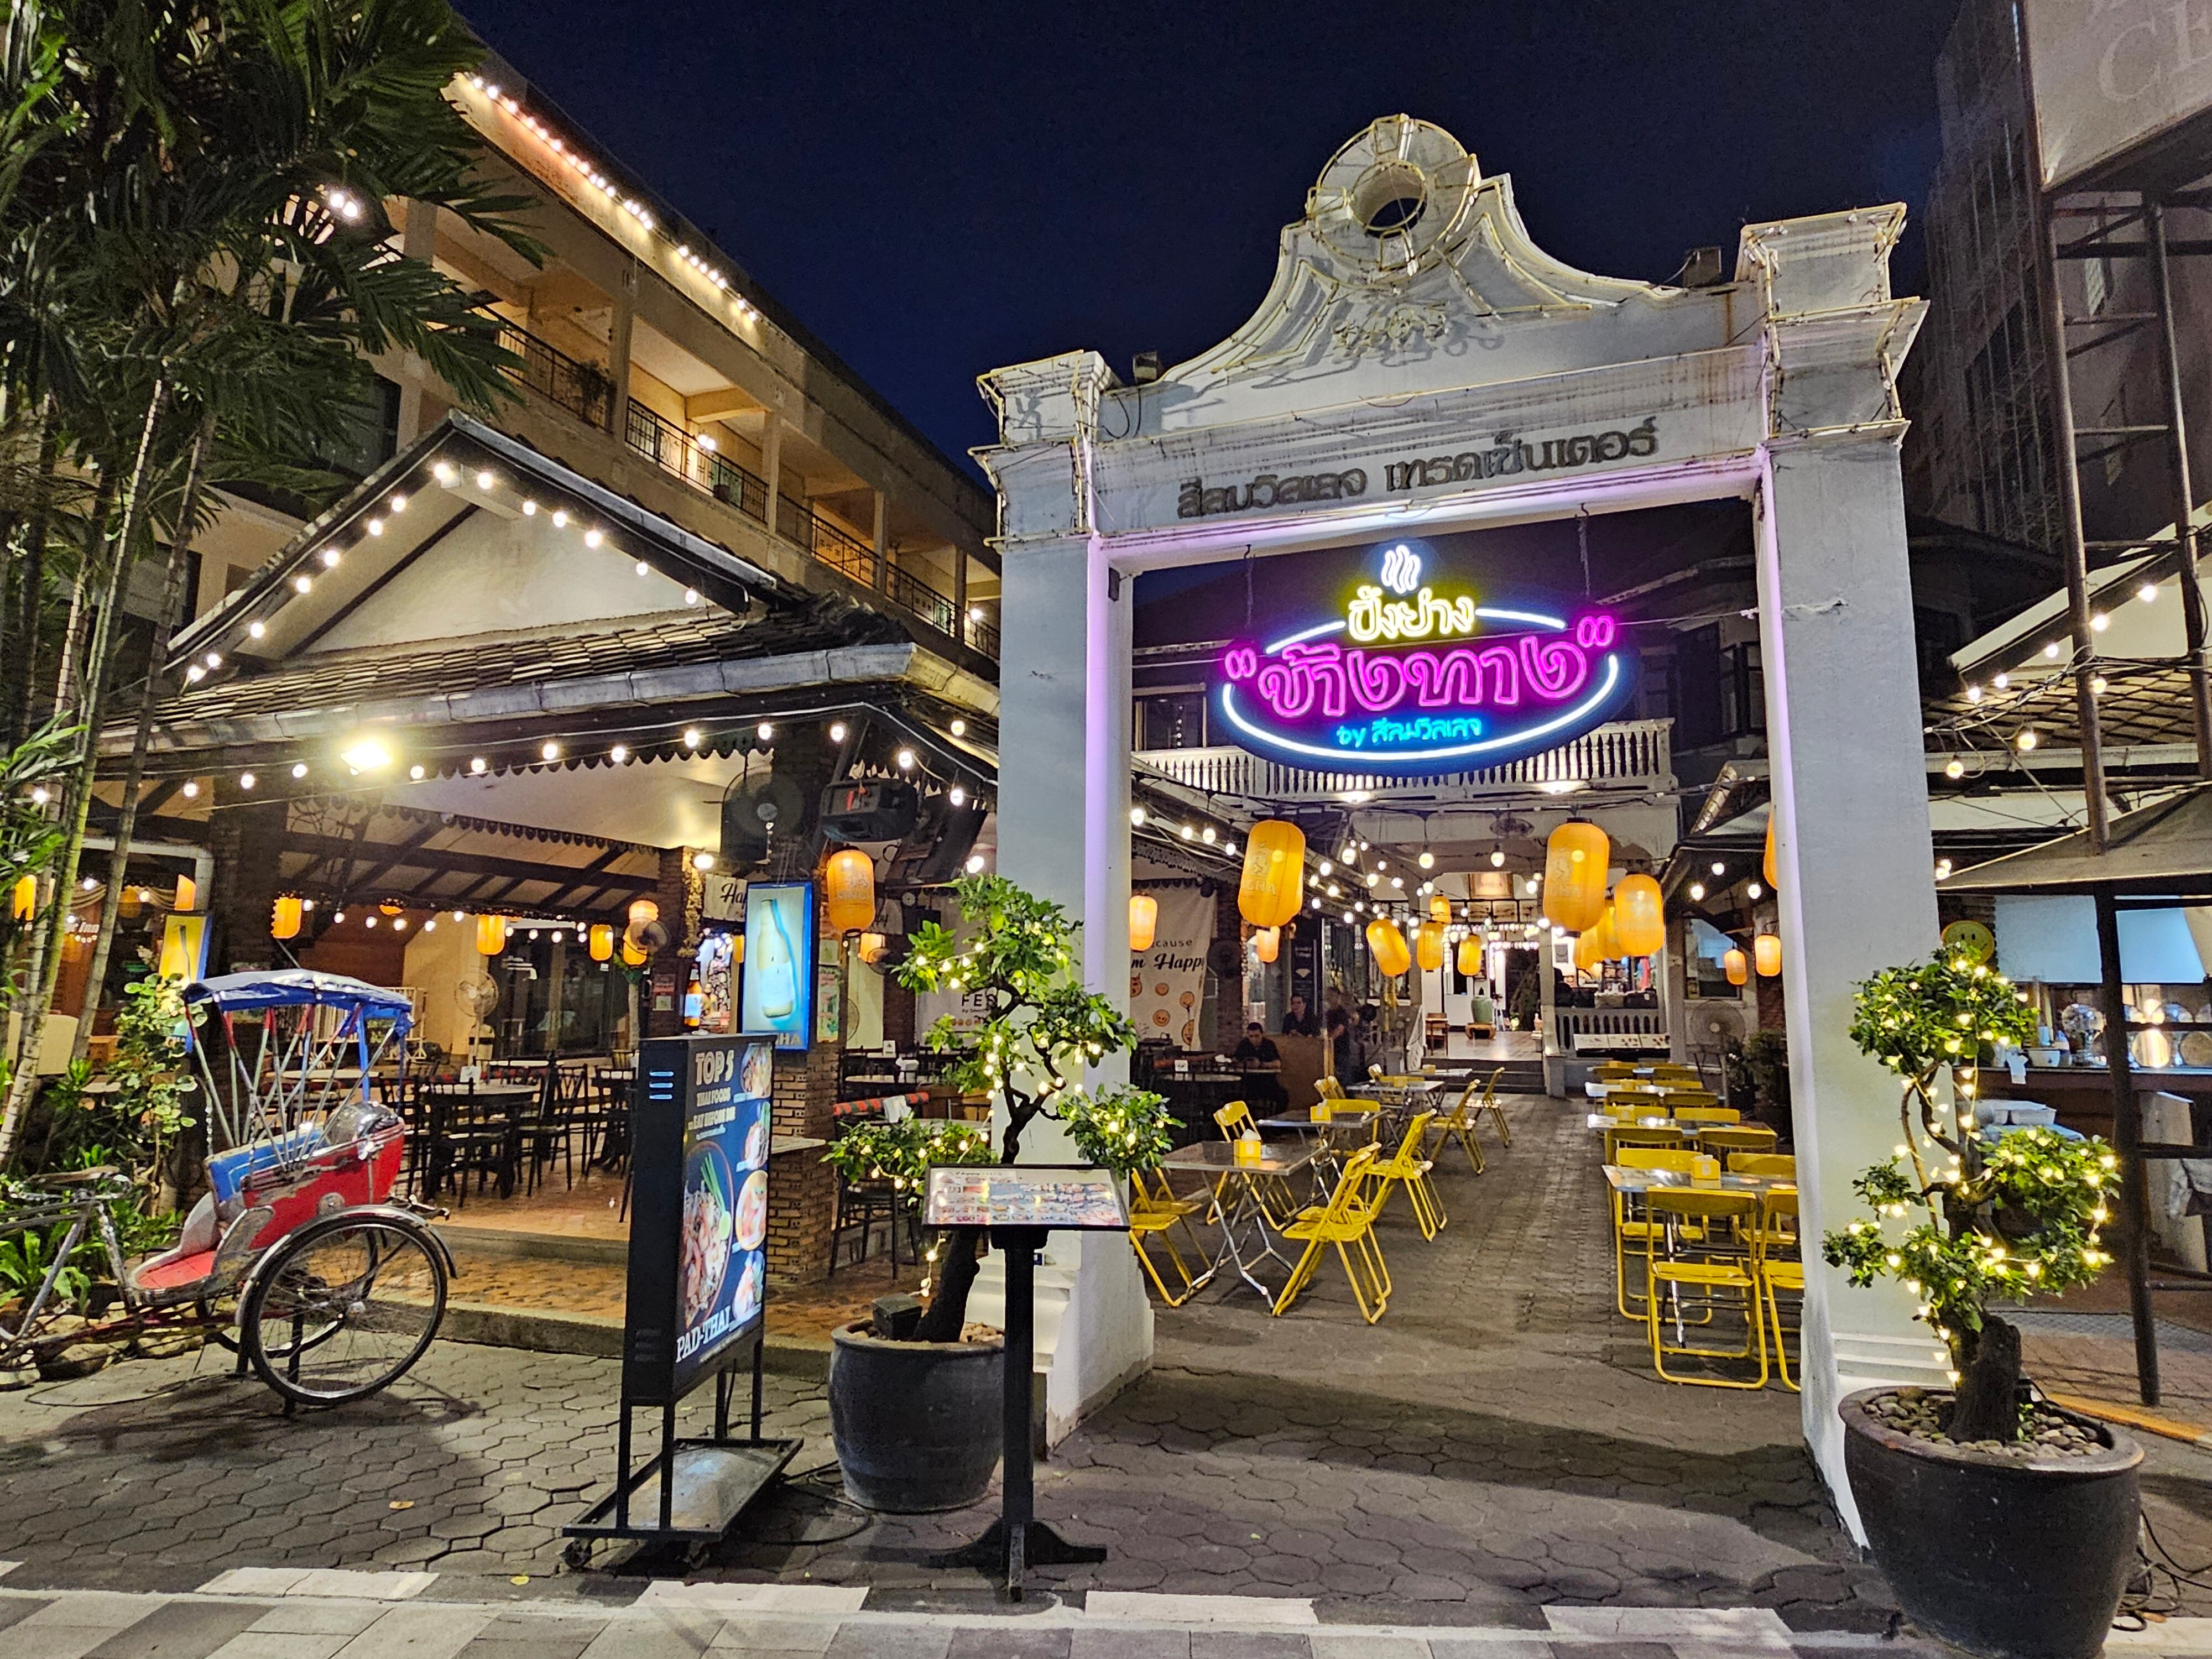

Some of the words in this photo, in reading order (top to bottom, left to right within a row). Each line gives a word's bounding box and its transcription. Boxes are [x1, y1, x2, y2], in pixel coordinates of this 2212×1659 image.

[1177, 468, 1368, 519] สีลมวิลเลจ
[1385, 416, 1660, 492] เทรดเซ็นเตอร์
[1348, 586, 1475, 641] ปิ้งย่าง
[1337, 725, 1366, 748] by
[1371, 717, 1482, 743] สีลมวิลเลจ
[1152, 939, 1192, 947] cause
[696, 1051, 725, 1086] TOP
[725, 1050, 734, 1082] 5
[676, 1305, 732, 1364] PAD-THAI
